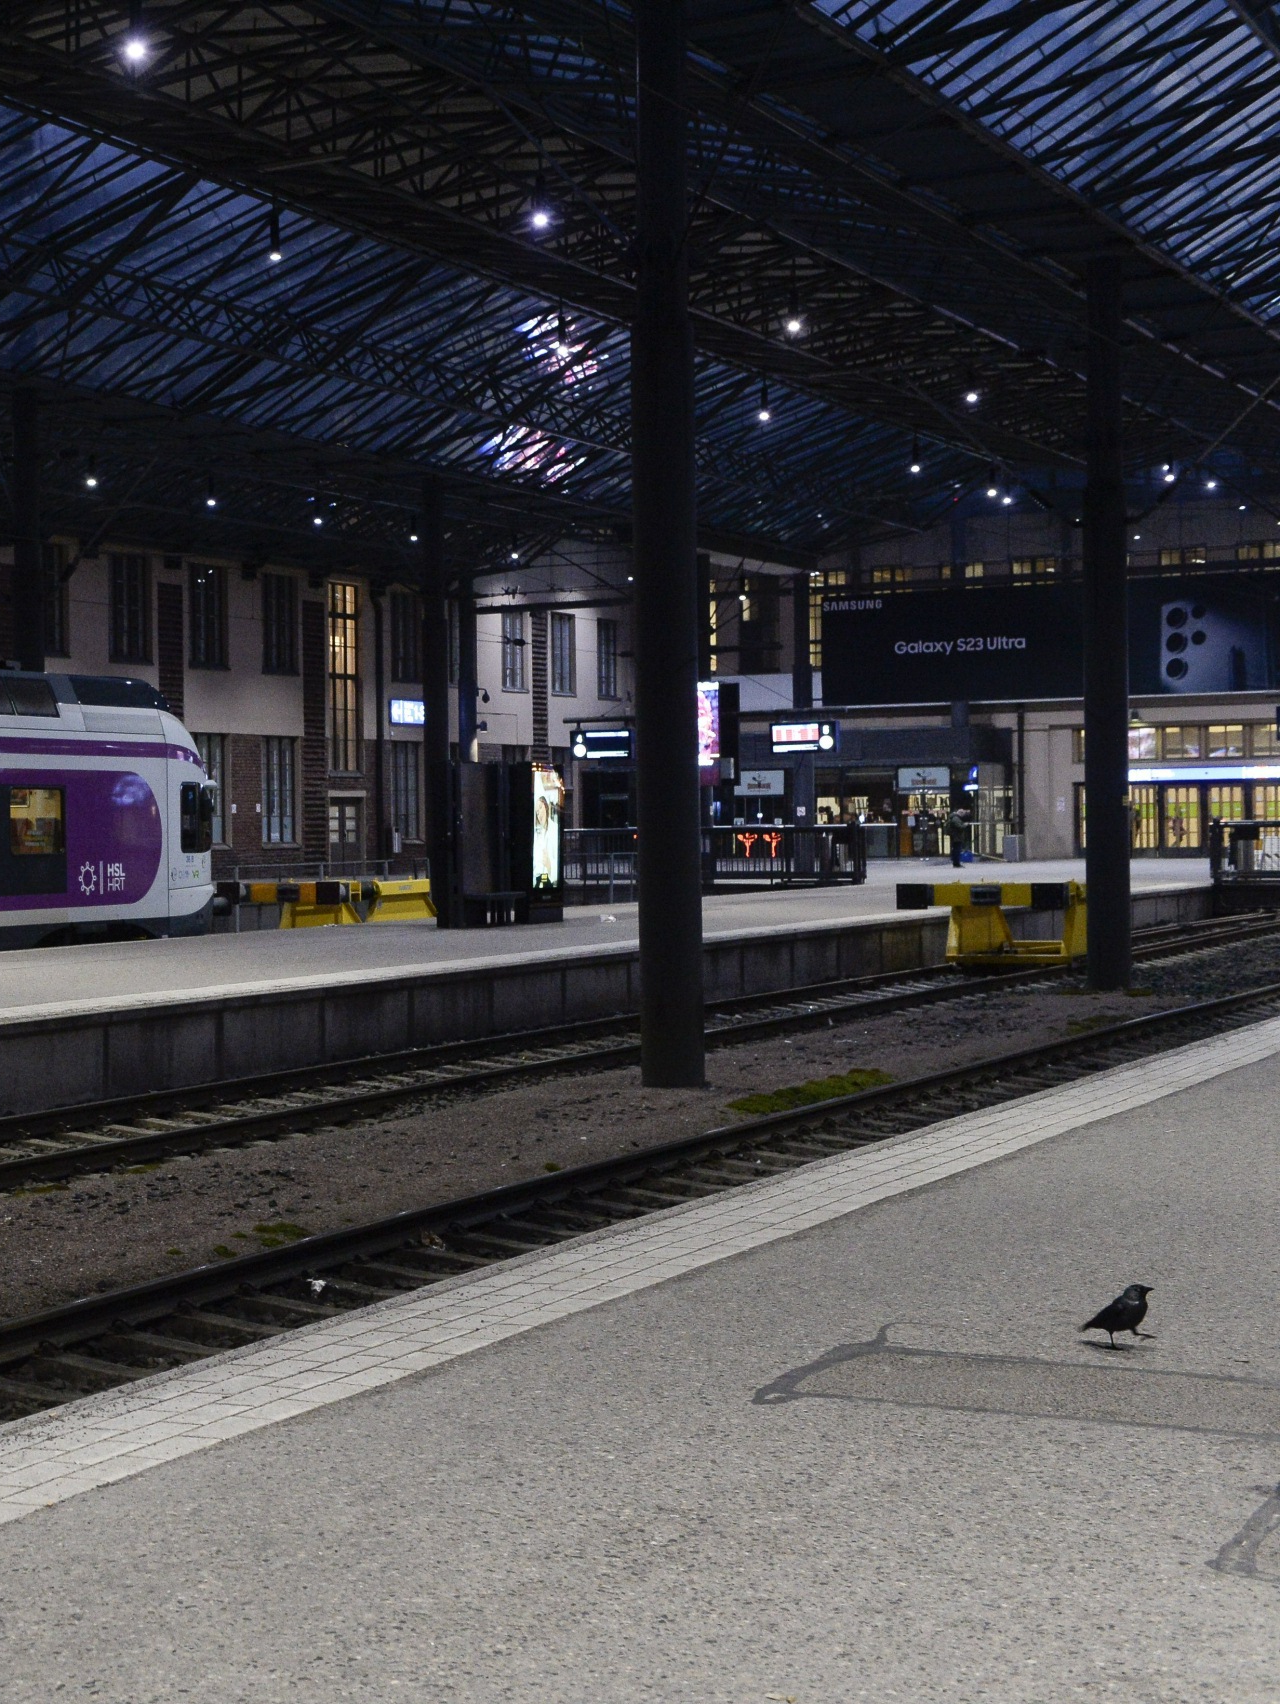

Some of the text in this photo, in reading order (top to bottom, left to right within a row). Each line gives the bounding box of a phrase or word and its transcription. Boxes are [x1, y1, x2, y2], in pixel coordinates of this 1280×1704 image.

[822, 599, 882, 612] SAMSUNG
[894, 635, 1026, 655] Galaxy S23 Ultra
[107, 863, 126, 876] HSL
[107, 877, 126, 891] HRT
